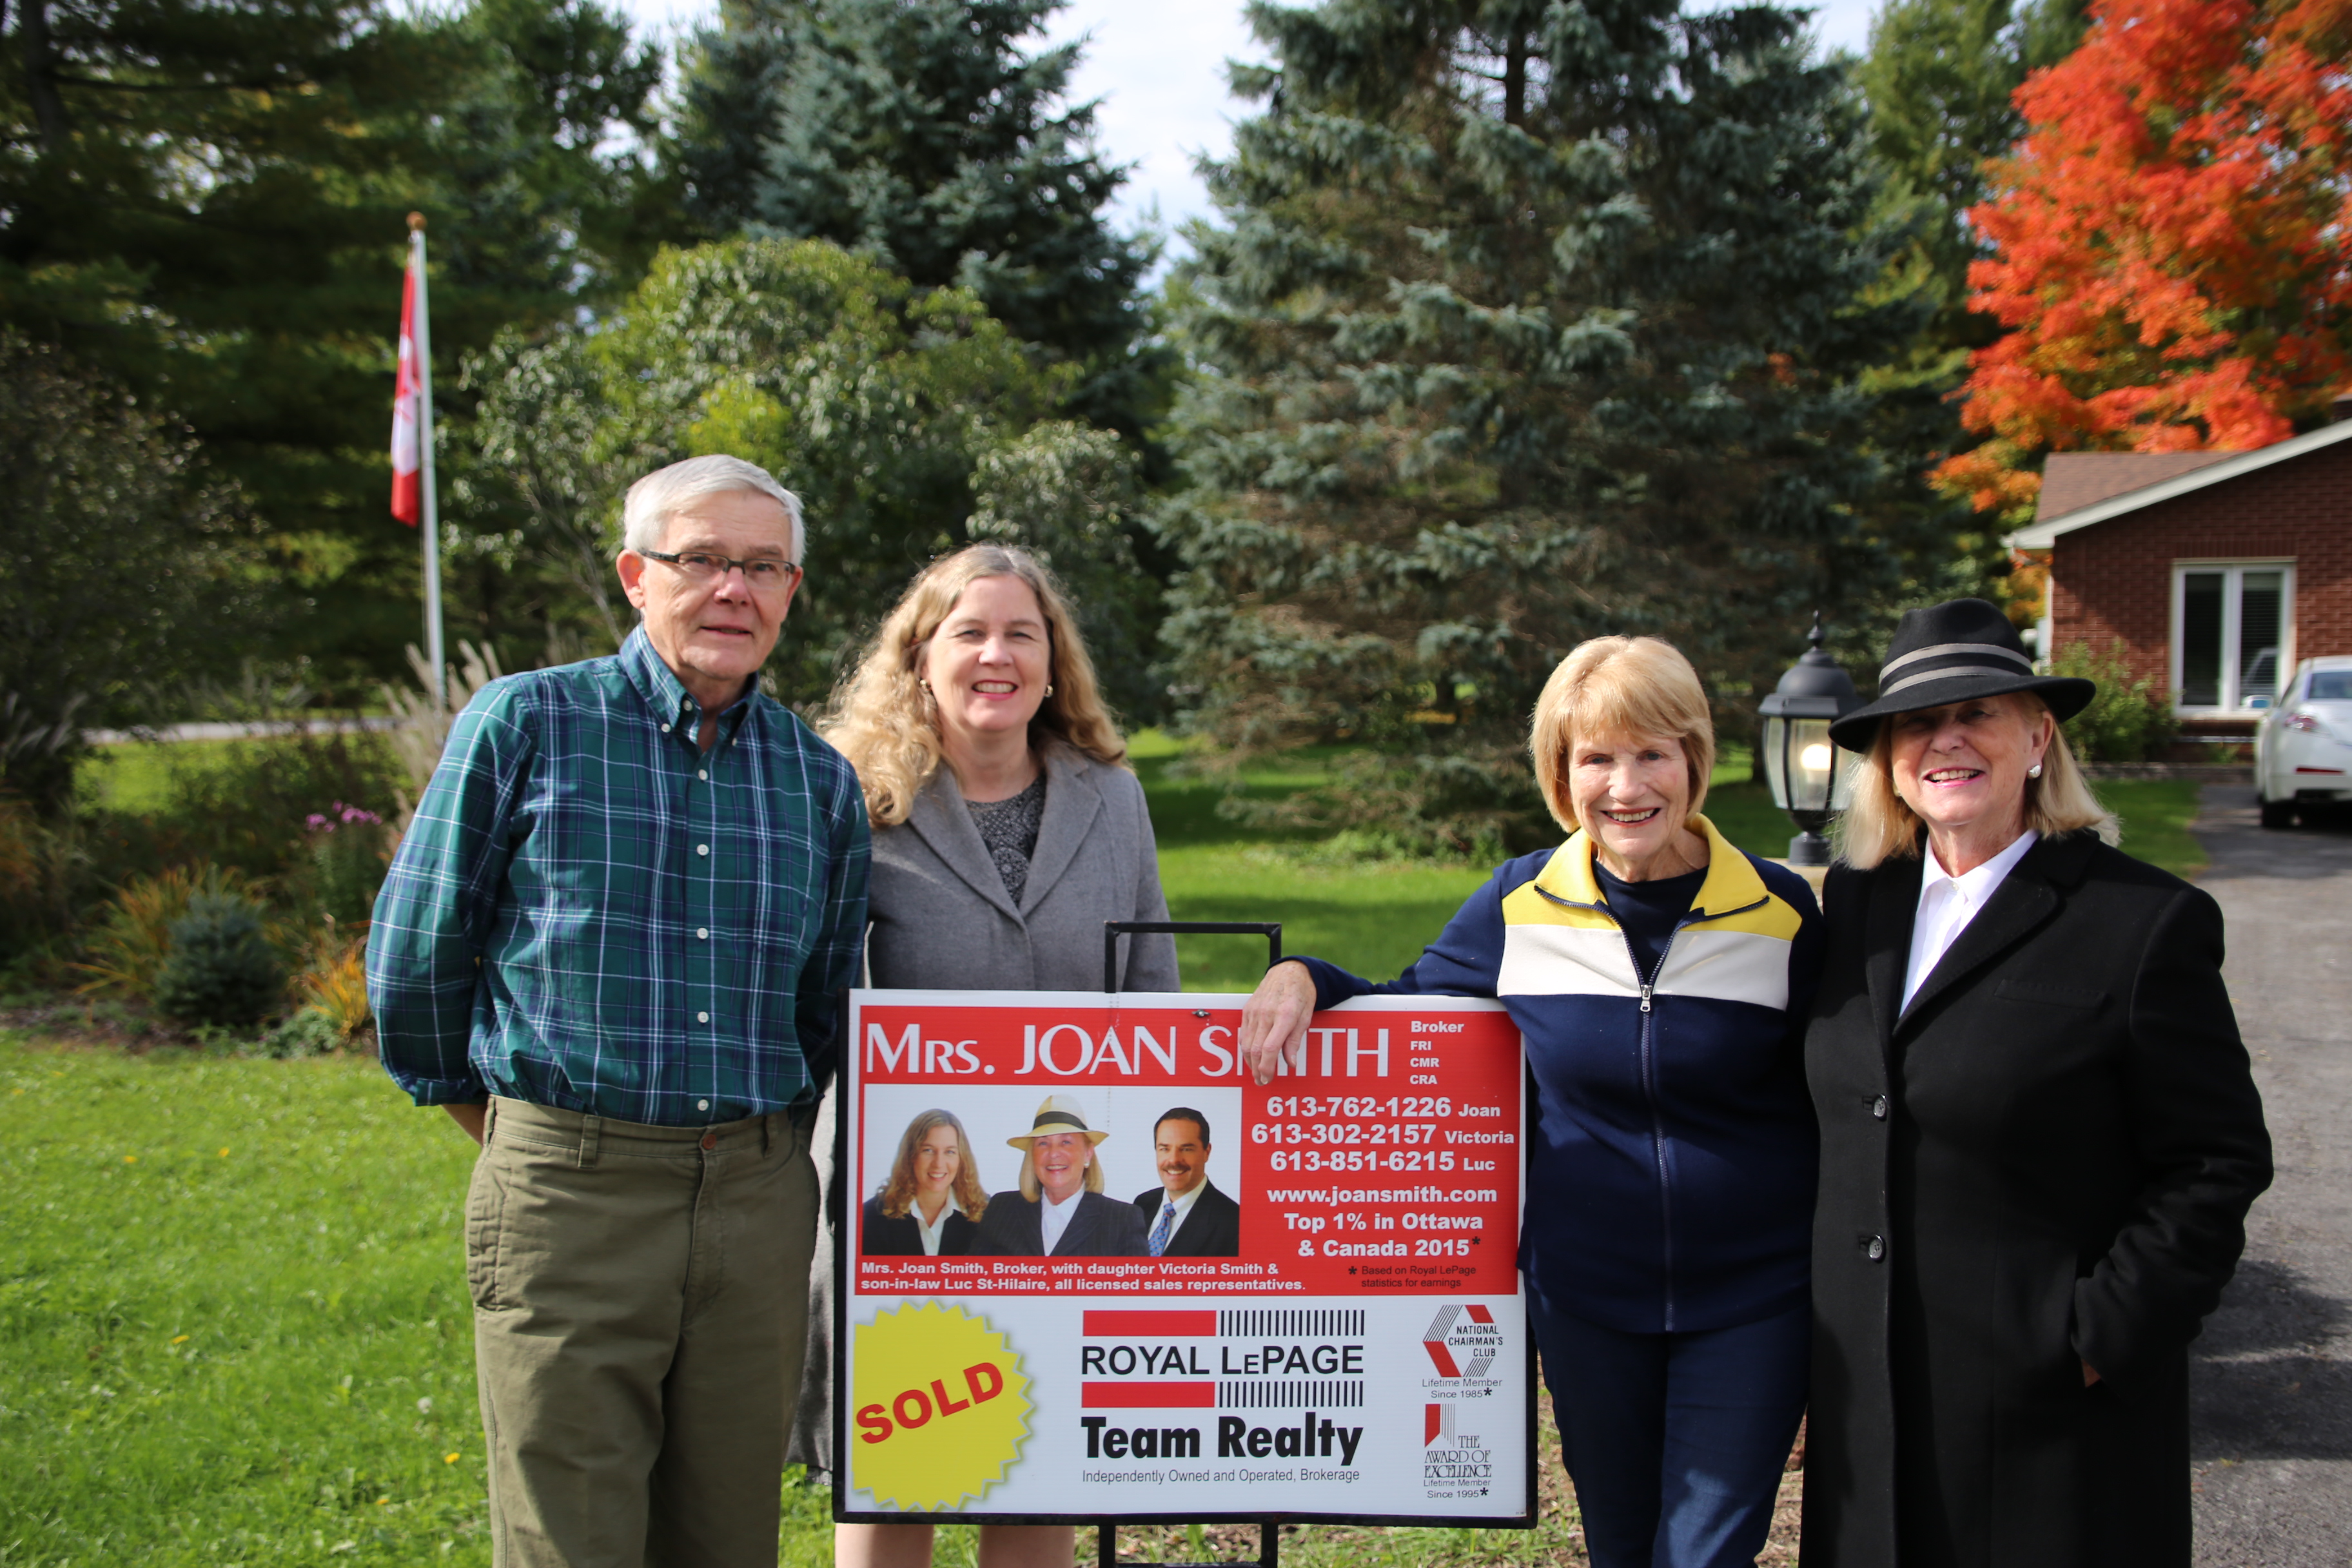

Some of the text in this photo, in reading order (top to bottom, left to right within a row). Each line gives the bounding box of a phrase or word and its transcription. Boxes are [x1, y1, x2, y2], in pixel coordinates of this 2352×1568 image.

[1411, 1021, 1464, 1033] Broker
[1014, 1024, 1176, 1075] JOAN
[1410, 1041, 1431, 1050] FRI
[1410, 1058, 1439, 1067] CMR
[1410, 1075, 1437, 1084] CRA
[1267, 1097, 1500, 1117] 613-762-1226 Joan
[1251, 1124, 1514, 1144] 613-302-2157 Victoria
[1270, 1151, 1495, 1171] 613-851-6215 Luc
[1267, 1186, 1497, 1206] www.joansmith.com
[1284, 1213, 1483, 1233] Top 1% in Ottawa
[1298, 1239, 1315, 1256] &
[1322, 1239, 1407, 1256] Canada
[861, 1262, 1279, 1277] Mrs. Joan Smith, Broker, with daughter Victoria Smith &
[1362, 1266, 1392, 1275] Based
[1410, 1266, 1437, 1277] Royal
[1440, 1266, 1476, 1277] LePage
[861, 1279, 1306, 1292] son-in-law Luc St-Hilaire, all licensed sales representatives.
[1361, 1278, 1462, 1289] statistics for earnings
[1456, 1326, 1499, 1335] NATIONAL
[1449, 1337, 1503, 1346] CHAIRMAN'S
[1473, 1348, 1496, 1357] CLUB
[1082, 1346, 1210, 1375] ROYAL
[1463, 1378, 1502, 1387] Member
[856, 1362, 1004, 1444] SOLD
[1081, 1412, 1364, 1466] Team Realty
[1458, 1435, 1480, 1448] THE
[1424, 1449, 1491, 1463] AWARD OF
[1083, 1468, 1360, 1485] Independently Owned and Operated, Brokerage
[1424, 1464, 1492, 1478] EXCELLENCE
[1427, 1490, 1453, 1498] Since
